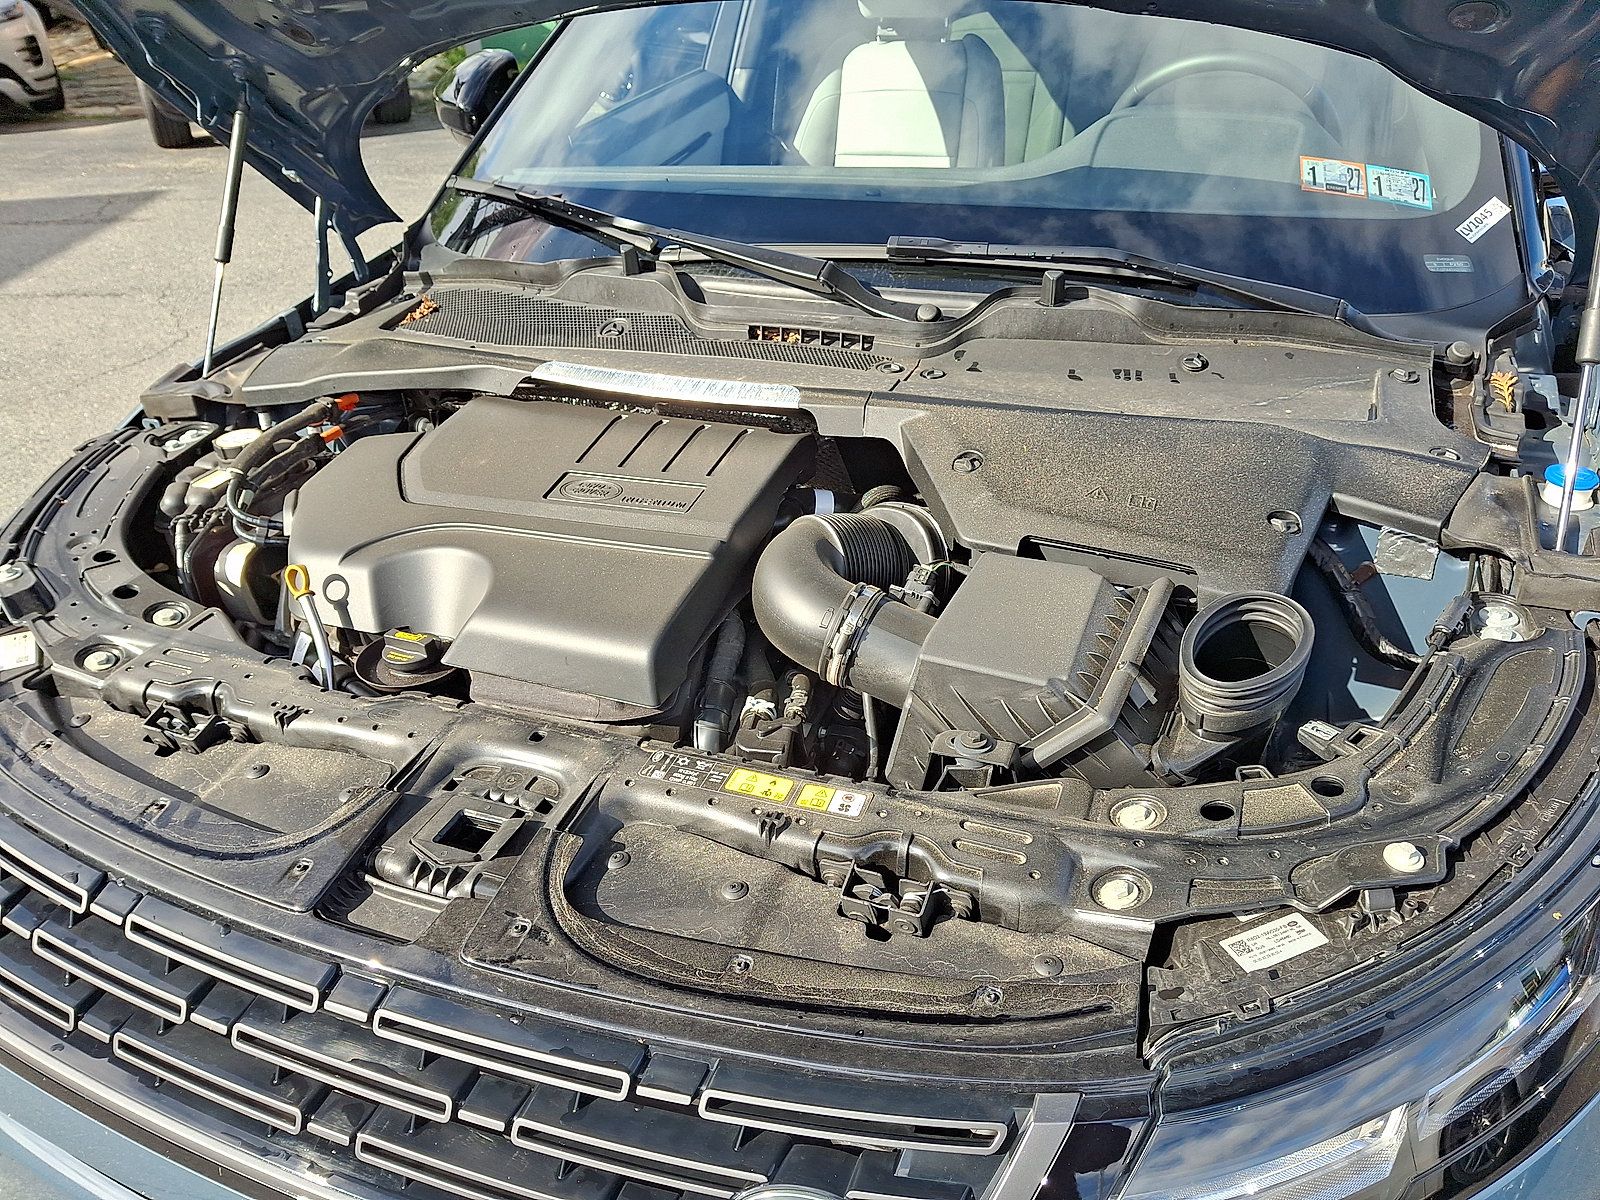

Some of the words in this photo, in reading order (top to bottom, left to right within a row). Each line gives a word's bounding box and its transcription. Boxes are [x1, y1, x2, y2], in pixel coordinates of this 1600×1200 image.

[1309, 165, 1317, 186] 1
[1346, 167, 1361, 192] 27
[1374, 175, 1383, 197] 1
[1411, 177, 1426, 203] 27
[1459, 208, 1494, 238] LV1045
